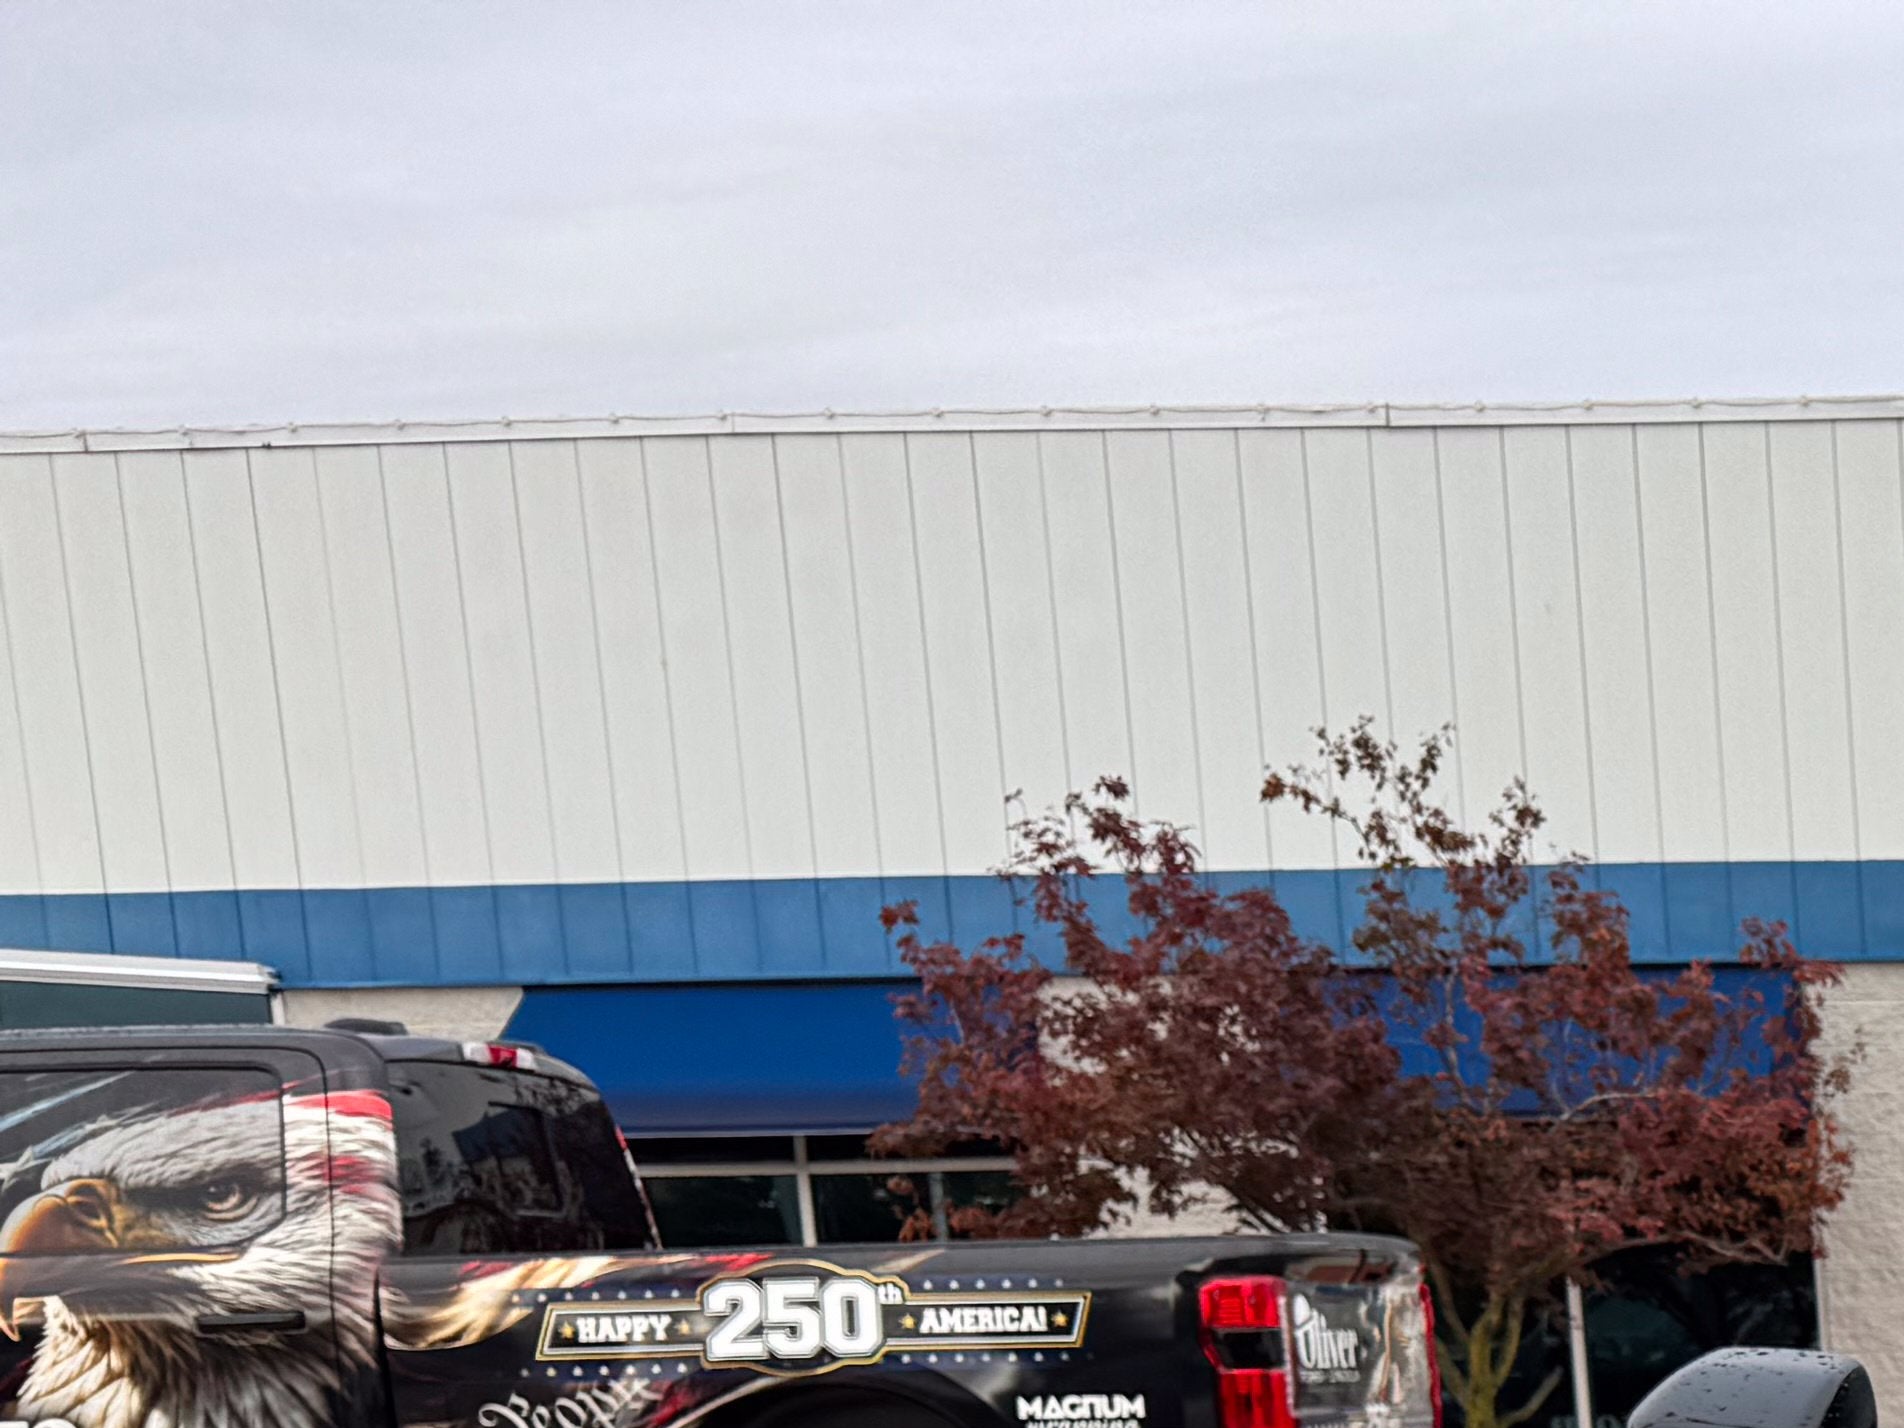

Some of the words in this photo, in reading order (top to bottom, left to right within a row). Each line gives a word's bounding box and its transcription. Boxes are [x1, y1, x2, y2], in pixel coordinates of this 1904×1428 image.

[577, 1313, 671, 1342] HAPPY
[703, 1276, 901, 1361] 250th
[919, 1306, 1048, 1333] AMERICA!
[1016, 1393, 1147, 1420] MAGNUM
